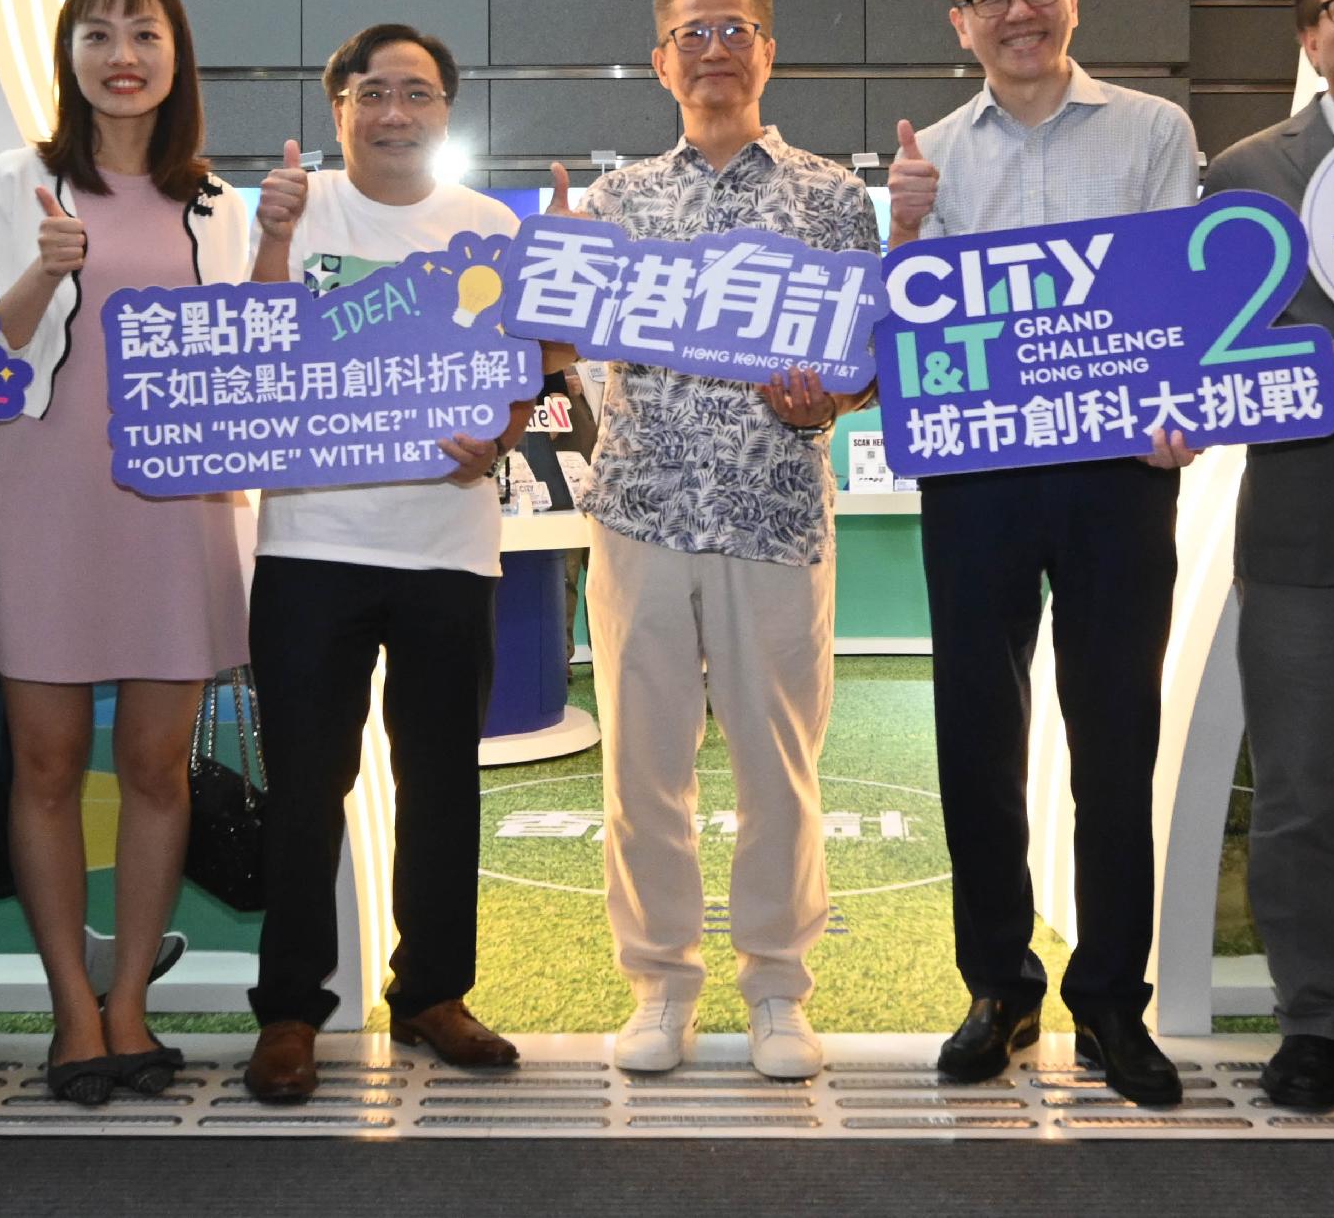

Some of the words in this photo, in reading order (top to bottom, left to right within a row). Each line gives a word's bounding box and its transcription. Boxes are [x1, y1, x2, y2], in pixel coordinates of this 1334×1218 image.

[320, 277, 421, 341] IDEA!
[515, 229, 875, 363] 香港有計
[886, 233, 1115, 323] CITY
[1187, 205, 1316, 366] 2
[117, 297, 302, 360] 諗點解
[1014, 309, 1114, 339] GRAND
[1017, 326, 1184, 364] CHALLENGE
[123, 349, 531, 411] 不如諗點用創科拆解！
[682, 346, 729, 363] HONG
[732, 351, 794, 370] KONG'S
[895, 320, 1005, 398] I&T
[1020, 362, 1083, 385] HONG
[1088, 356, 1150, 379] KONG
[124, 422, 203, 447] TURN
[426, 404, 495, 429] INTO
[853, 438, 870, 447] SCAN
[906, 366, 1324, 459] 城市創科大挑戰
[309, 442, 385, 468] WITH
